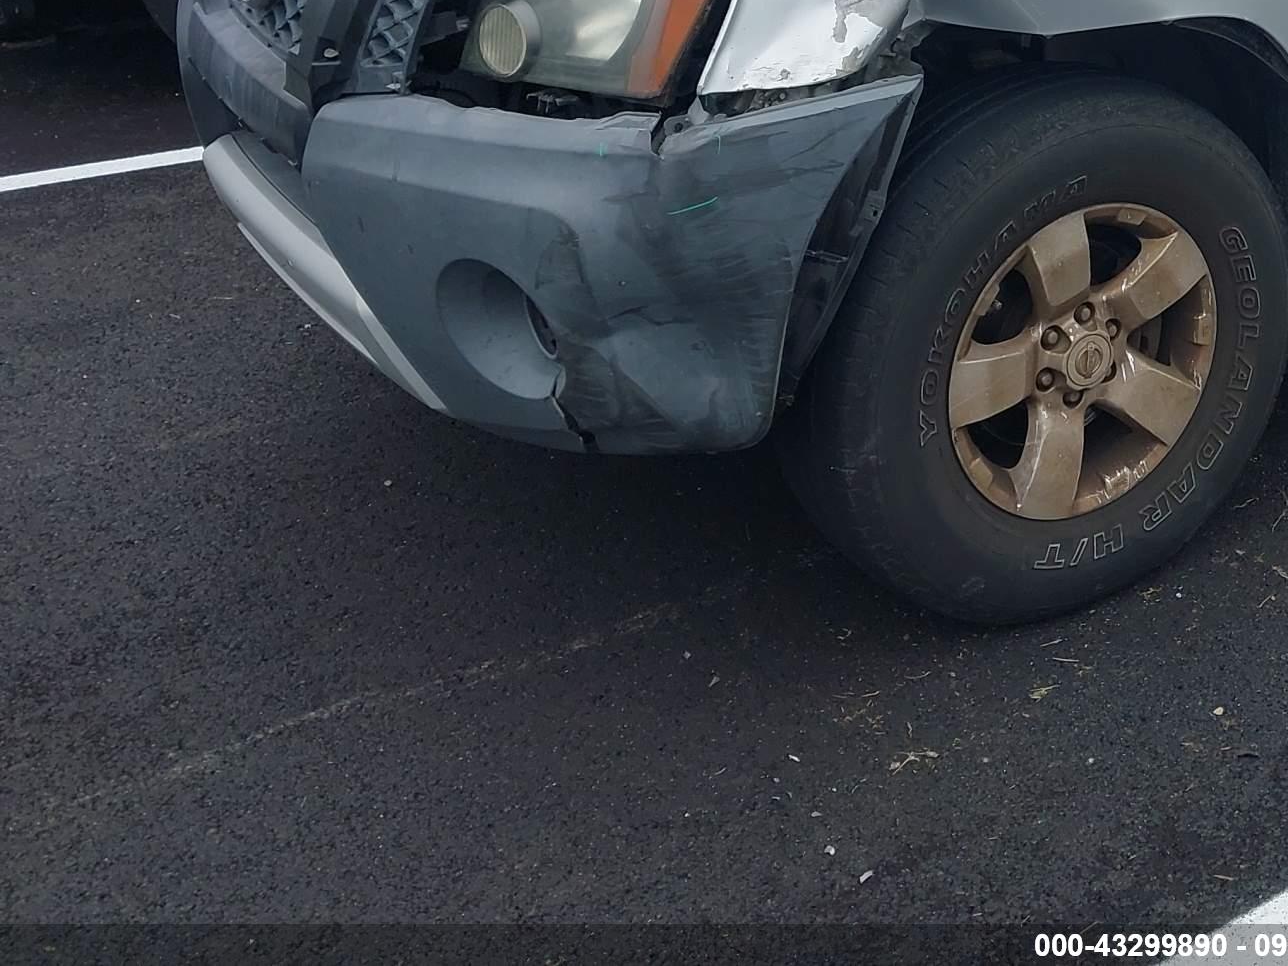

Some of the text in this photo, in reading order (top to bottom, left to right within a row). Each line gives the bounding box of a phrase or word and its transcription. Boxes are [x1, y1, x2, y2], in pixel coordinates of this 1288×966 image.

[919, 174, 1088, 448] YOKOHAMA
[1033, 225, 1261, 570] GEOLANDAR H/T
